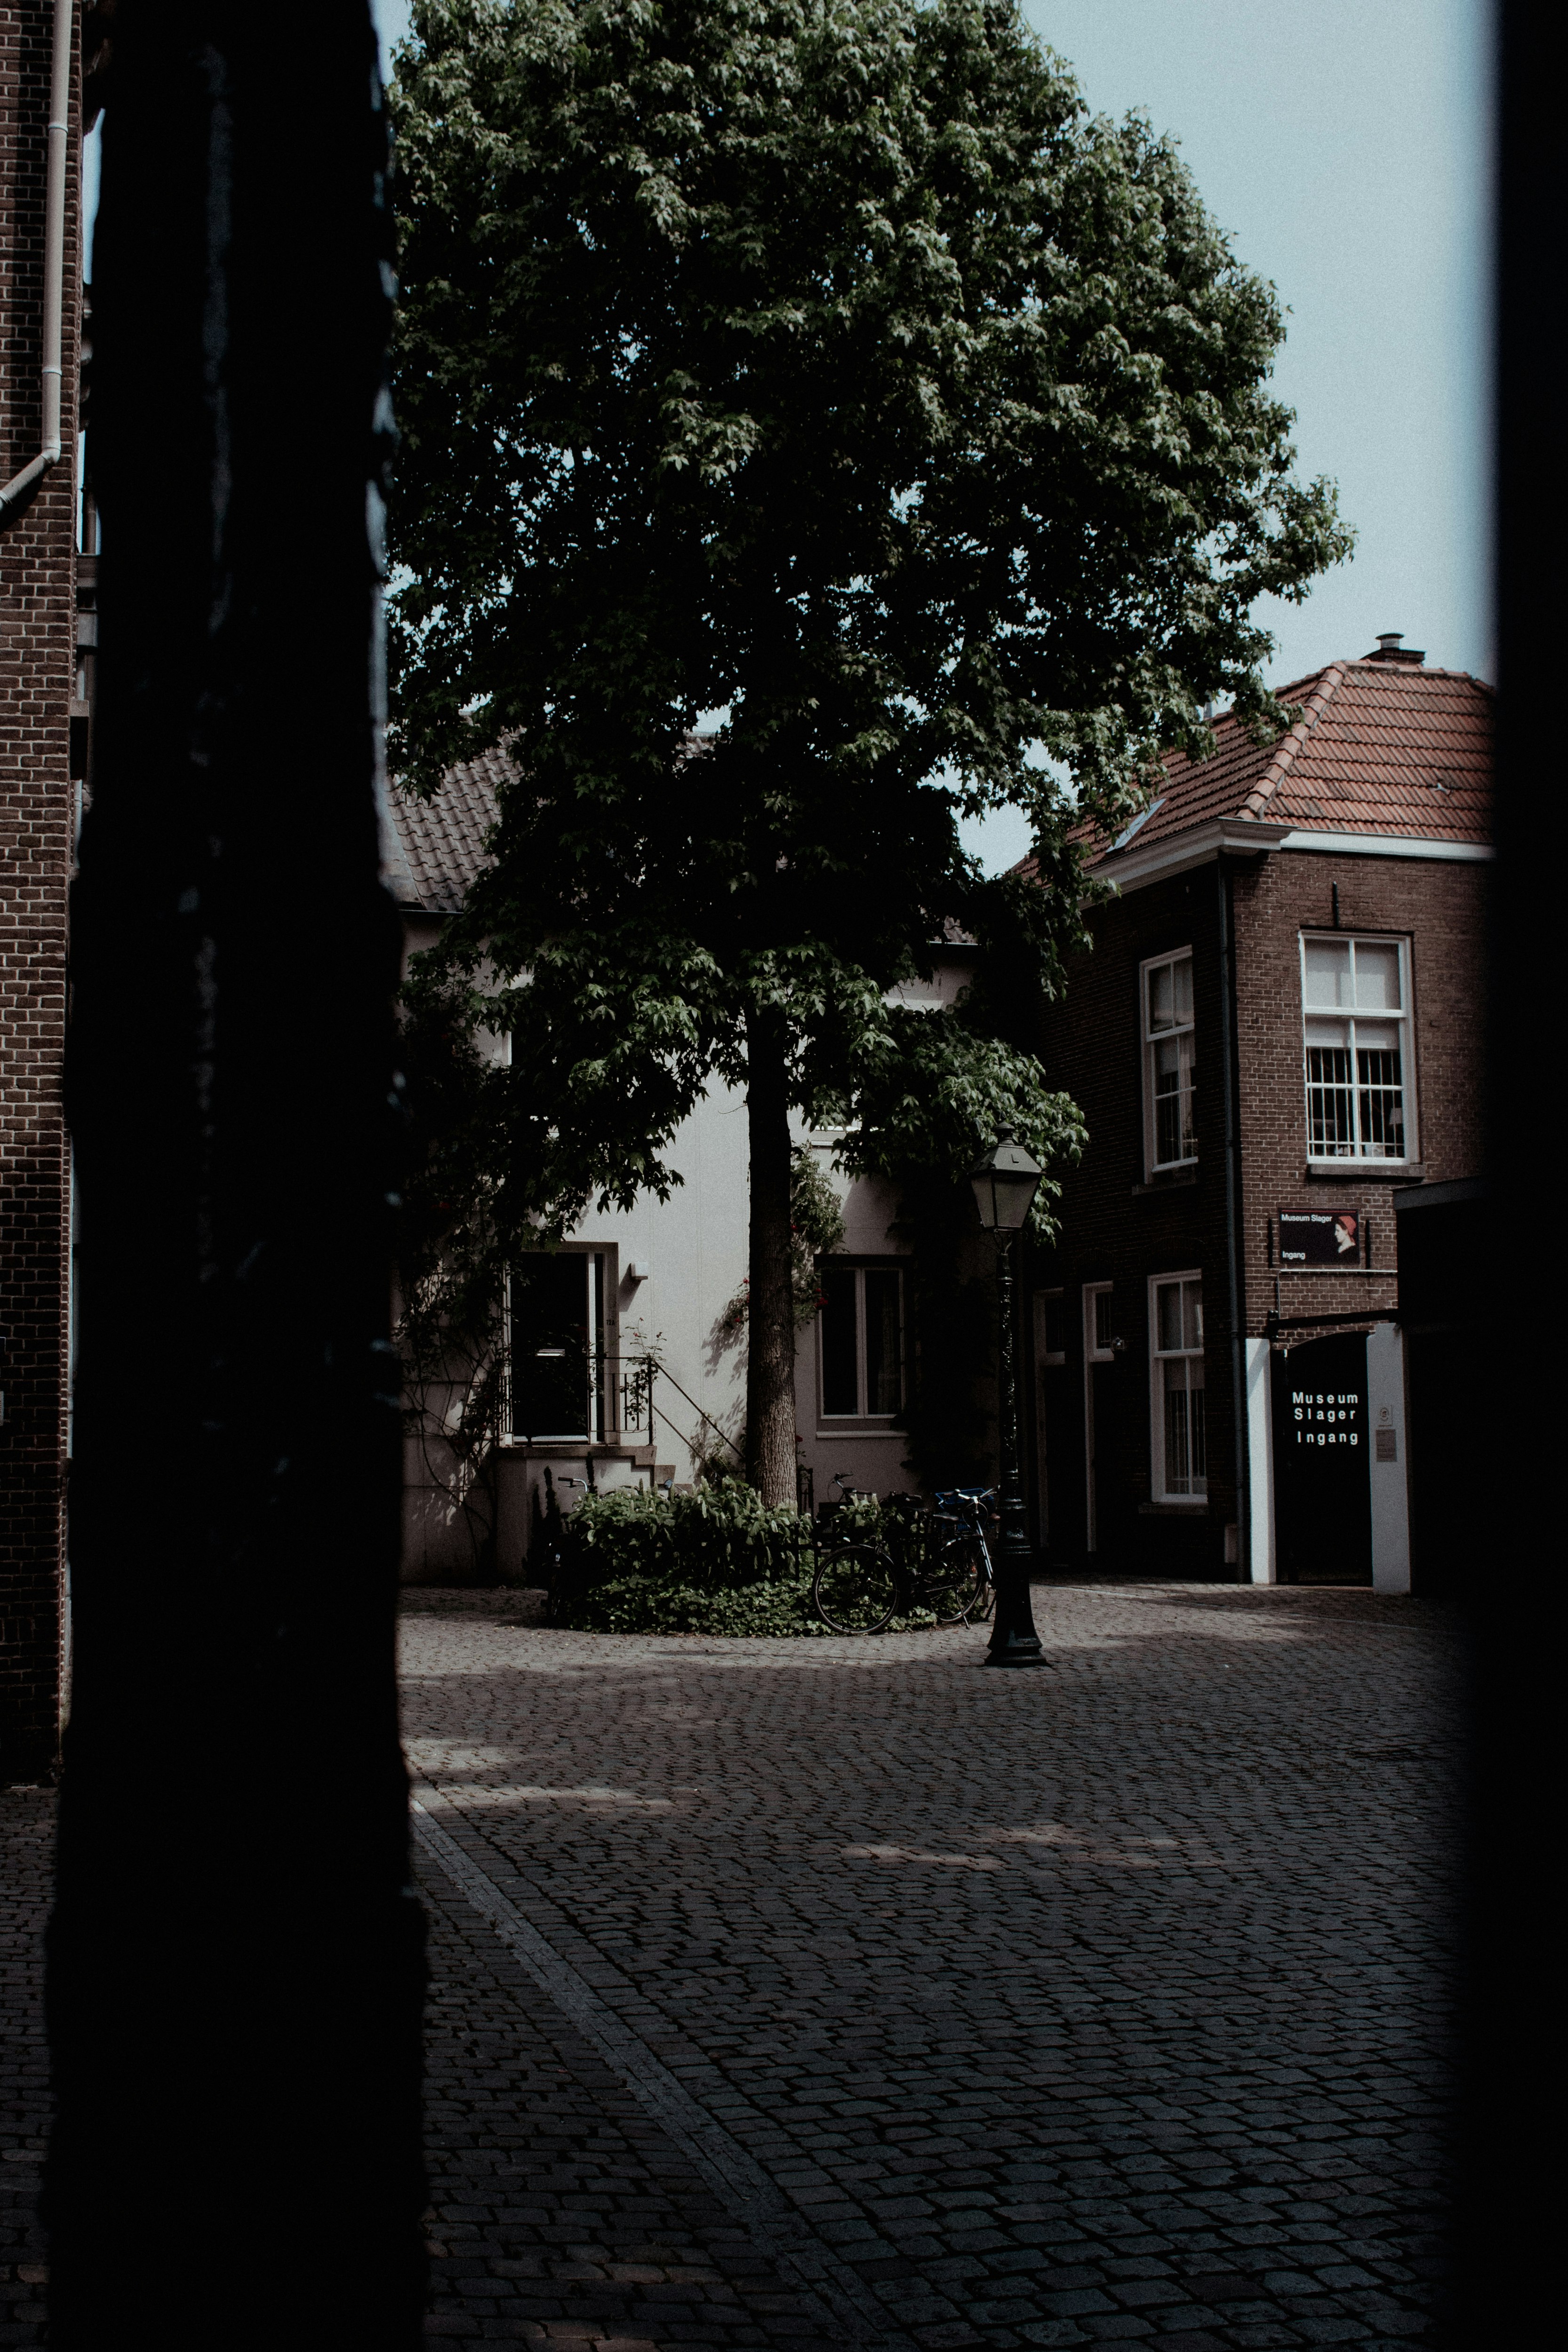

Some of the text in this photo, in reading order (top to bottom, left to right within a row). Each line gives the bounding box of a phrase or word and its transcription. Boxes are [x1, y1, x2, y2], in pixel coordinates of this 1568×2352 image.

[1310, 1214, 1332, 1223] Slager
[1282, 1250, 1305, 1260] Ingang
[1292, 1391, 1358, 1404] Museum
[1294, 1407, 1356, 1423] Slager
[1296, 1431, 1358, 1446] Ingang
